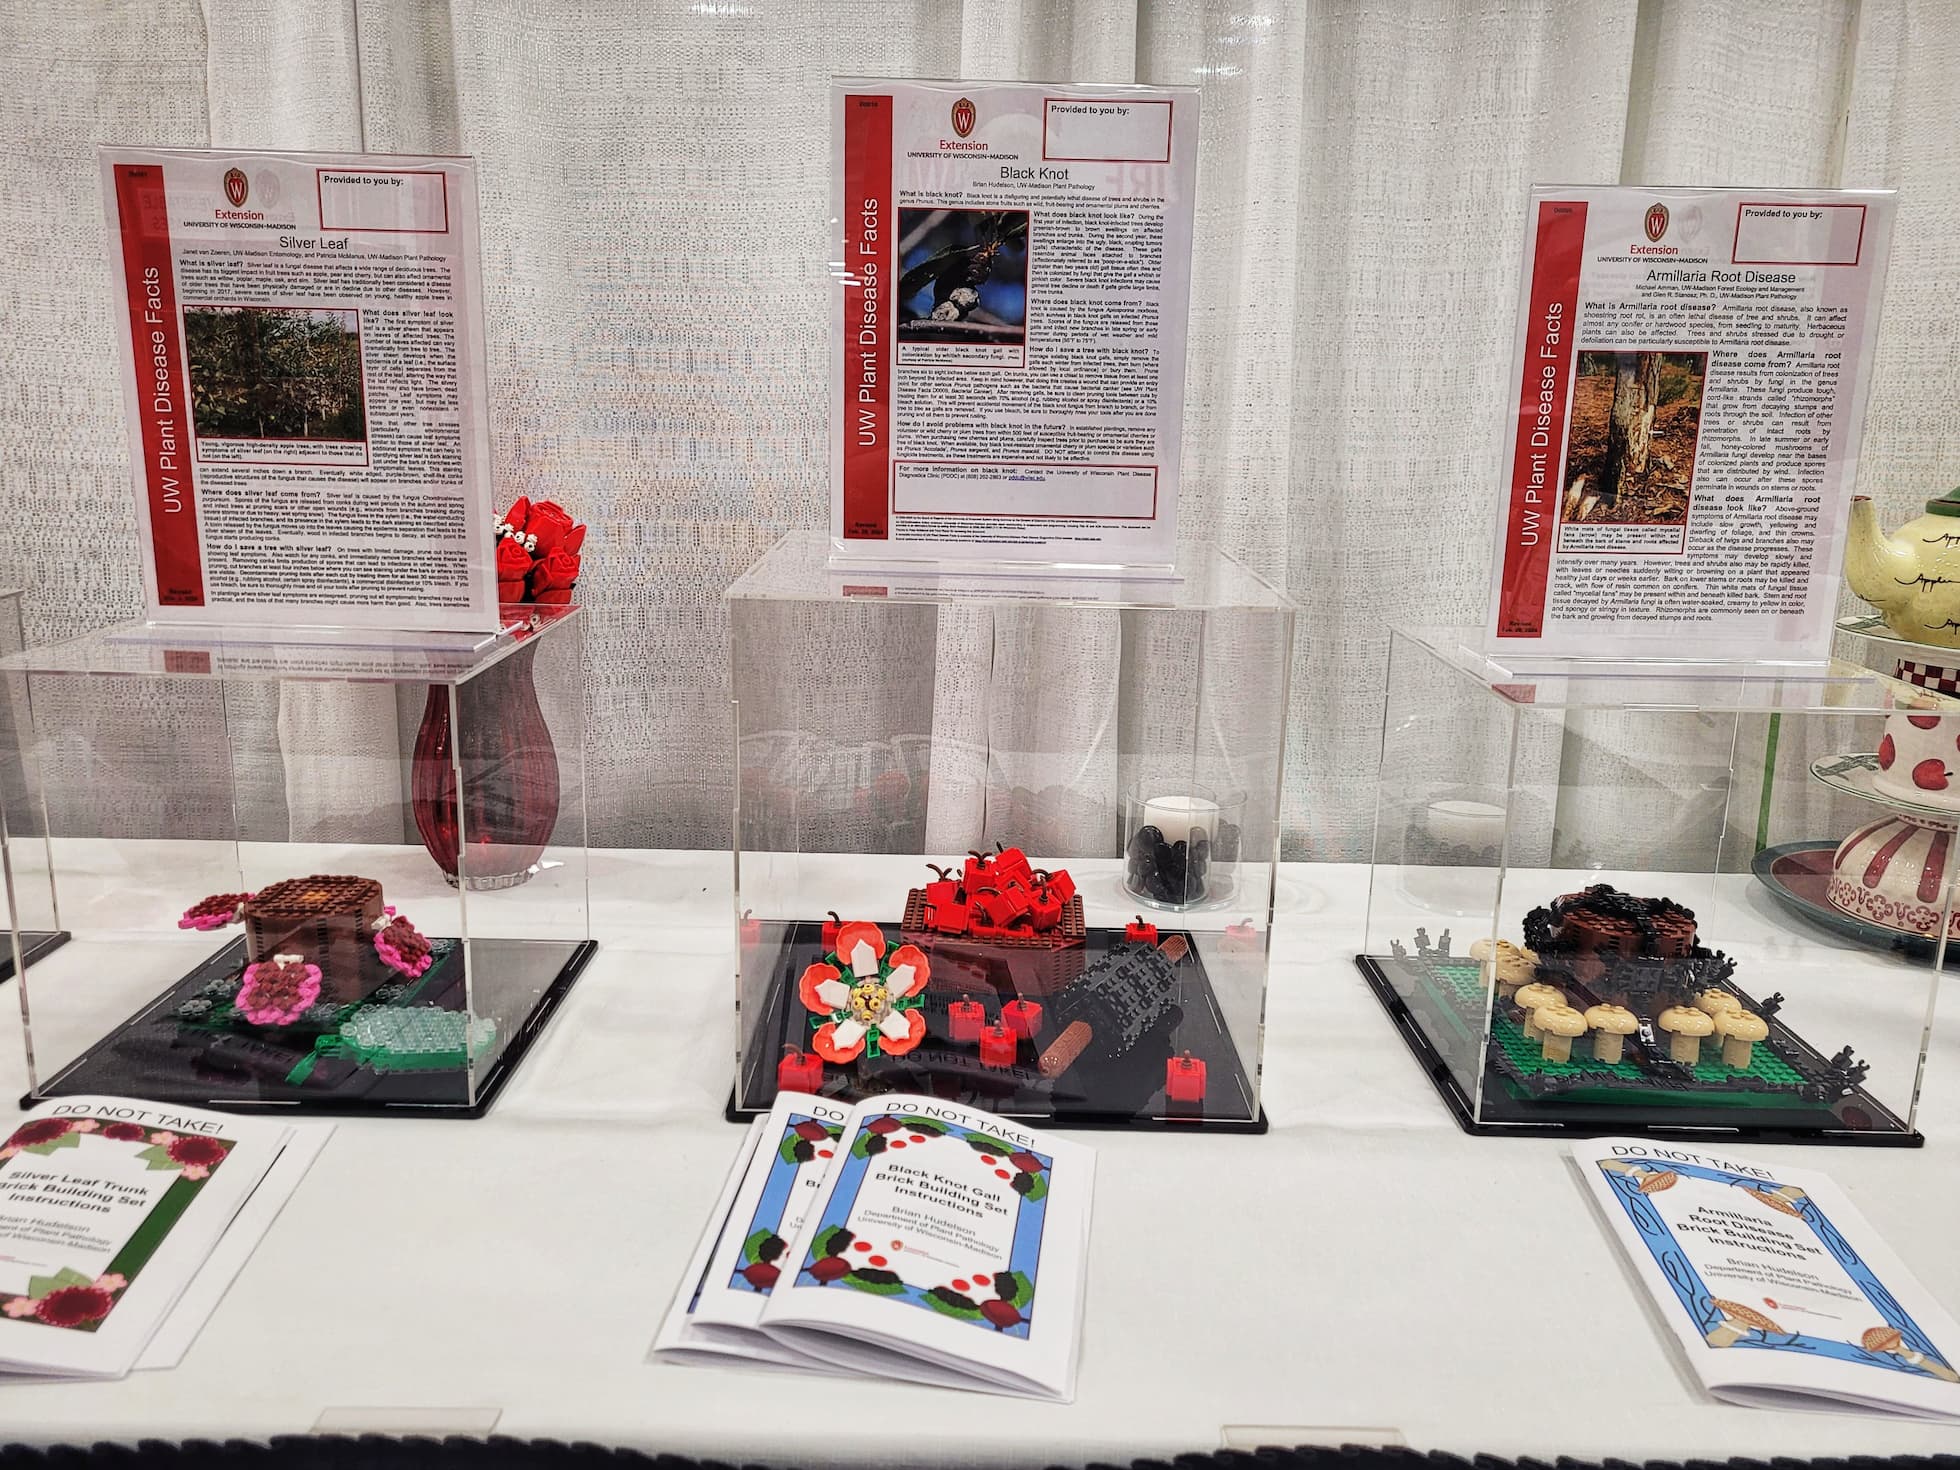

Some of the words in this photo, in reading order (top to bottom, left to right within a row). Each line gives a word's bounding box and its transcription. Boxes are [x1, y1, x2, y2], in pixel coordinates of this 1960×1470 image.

[1051, 104, 1087, 113] Provided
[1099, 107, 1114, 115] you
[1117, 106, 1129, 116] by:
[940, 139, 988, 150] Extension
[324, 175, 360, 184] Provided
[373, 178, 388, 186] you
[390, 177, 403, 186] by:
[1000, 166, 1034, 179] Black
[1039, 167, 1068, 180] Knot
[1068, 183, 1094, 191] Pathology
[215, 209, 263, 220] Extension
[1745, 208, 1780, 217] Provided
[1792, 211, 1807, 219] you
[1810, 210, 1822, 219] by:
[860, 198, 878, 255] Facts
[279, 235, 316, 248] Silver
[320, 237, 348, 249] Leaf
[1630, 244, 1678, 254] Extension
[1646, 269, 1706, 282] Armillaria
[1711, 270, 1741, 282] Root
[1745, 270, 1795, 283] Disease
[143, 267, 163, 323] Facts
[859, 263, 877, 345] Disease
[1585, 301, 1605, 309] What
[1619, 302, 1656, 310] Armillaria
[438, 310, 453, 318] look
[1540, 302, 1562, 358] Facts
[1711, 359, 1741, 367] disease
[1767, 360, 1791, 368] from?
[1712, 349, 1737, 357] Where
[1777, 350, 1814, 358] Armillaria
[150, 331, 172, 412] Disease
[859, 352, 877, 403] Plant
[1531, 366, 1556, 447] Disease
[859, 410, 876, 446] UW
[157, 420, 178, 470] Plant
[1525, 454, 1546, 503] Plant
[162, 477, 181, 513] UW
[1520, 510, 1541, 546] UW
[53, 1104, 92, 1115] DO
[96, 1105, 152, 1122] NOT
[156, 1114, 224, 1135] TAKE!
[813, 1106, 844, 1120] DO
[886, 1103, 918, 1112] DO
[925, 1106, 973, 1124] NOT
[977, 1119, 1035, 1148] TAKE!
[1611, 1146, 1647, 1156] DO
[1654, 1149, 1701, 1164] NOT
[1707, 1157, 1775, 1180] TAKE!
[8, 1171, 58, 1181] Silver
[61, 1174, 99, 1187] Leaf
[104, 1181, 149, 1196] Trunk
[43, 1184, 113, 1203] Building
[118, 1195, 147, 1207] Set
[875, 1173, 914, 1186] Brick
[919, 1181, 979, 1207] Building
[984, 1201, 1009, 1216] Set
[888, 1164, 929, 1179] Black
[934, 1174, 968, 1192] Knot
[972, 1187, 1001, 1202] Gall
[8, 1193, 111, 1213] Instructions
[894, 1186, 984, 1218] Instructions
[858, 1216, 902, 1230] University
[892, 1206, 921, 1218] Brian
[924, 1213, 976, 1236] Hudelson
[1688, 1214, 1728, 1226] Root
[1730, 1222, 1794, 1240] Disease
[1698, 1206, 1773, 1227] Armillaria
[864, 1210, 918, 1225] Department
[930, 1224, 953, 1236] Plant
[955, 1231, 1000, 1253] Pathology
[1676, 1223, 1720, 1234] Brick
[1724, 1229, 1792, 1250] Building
[1794, 1243, 1823, 1256] Set
[1708, 1236, 1807, 1261] Instructions
[1726, 1257, 1760, 1268] Brian
[1761, 1264, 1819, 1281] Hudelson
